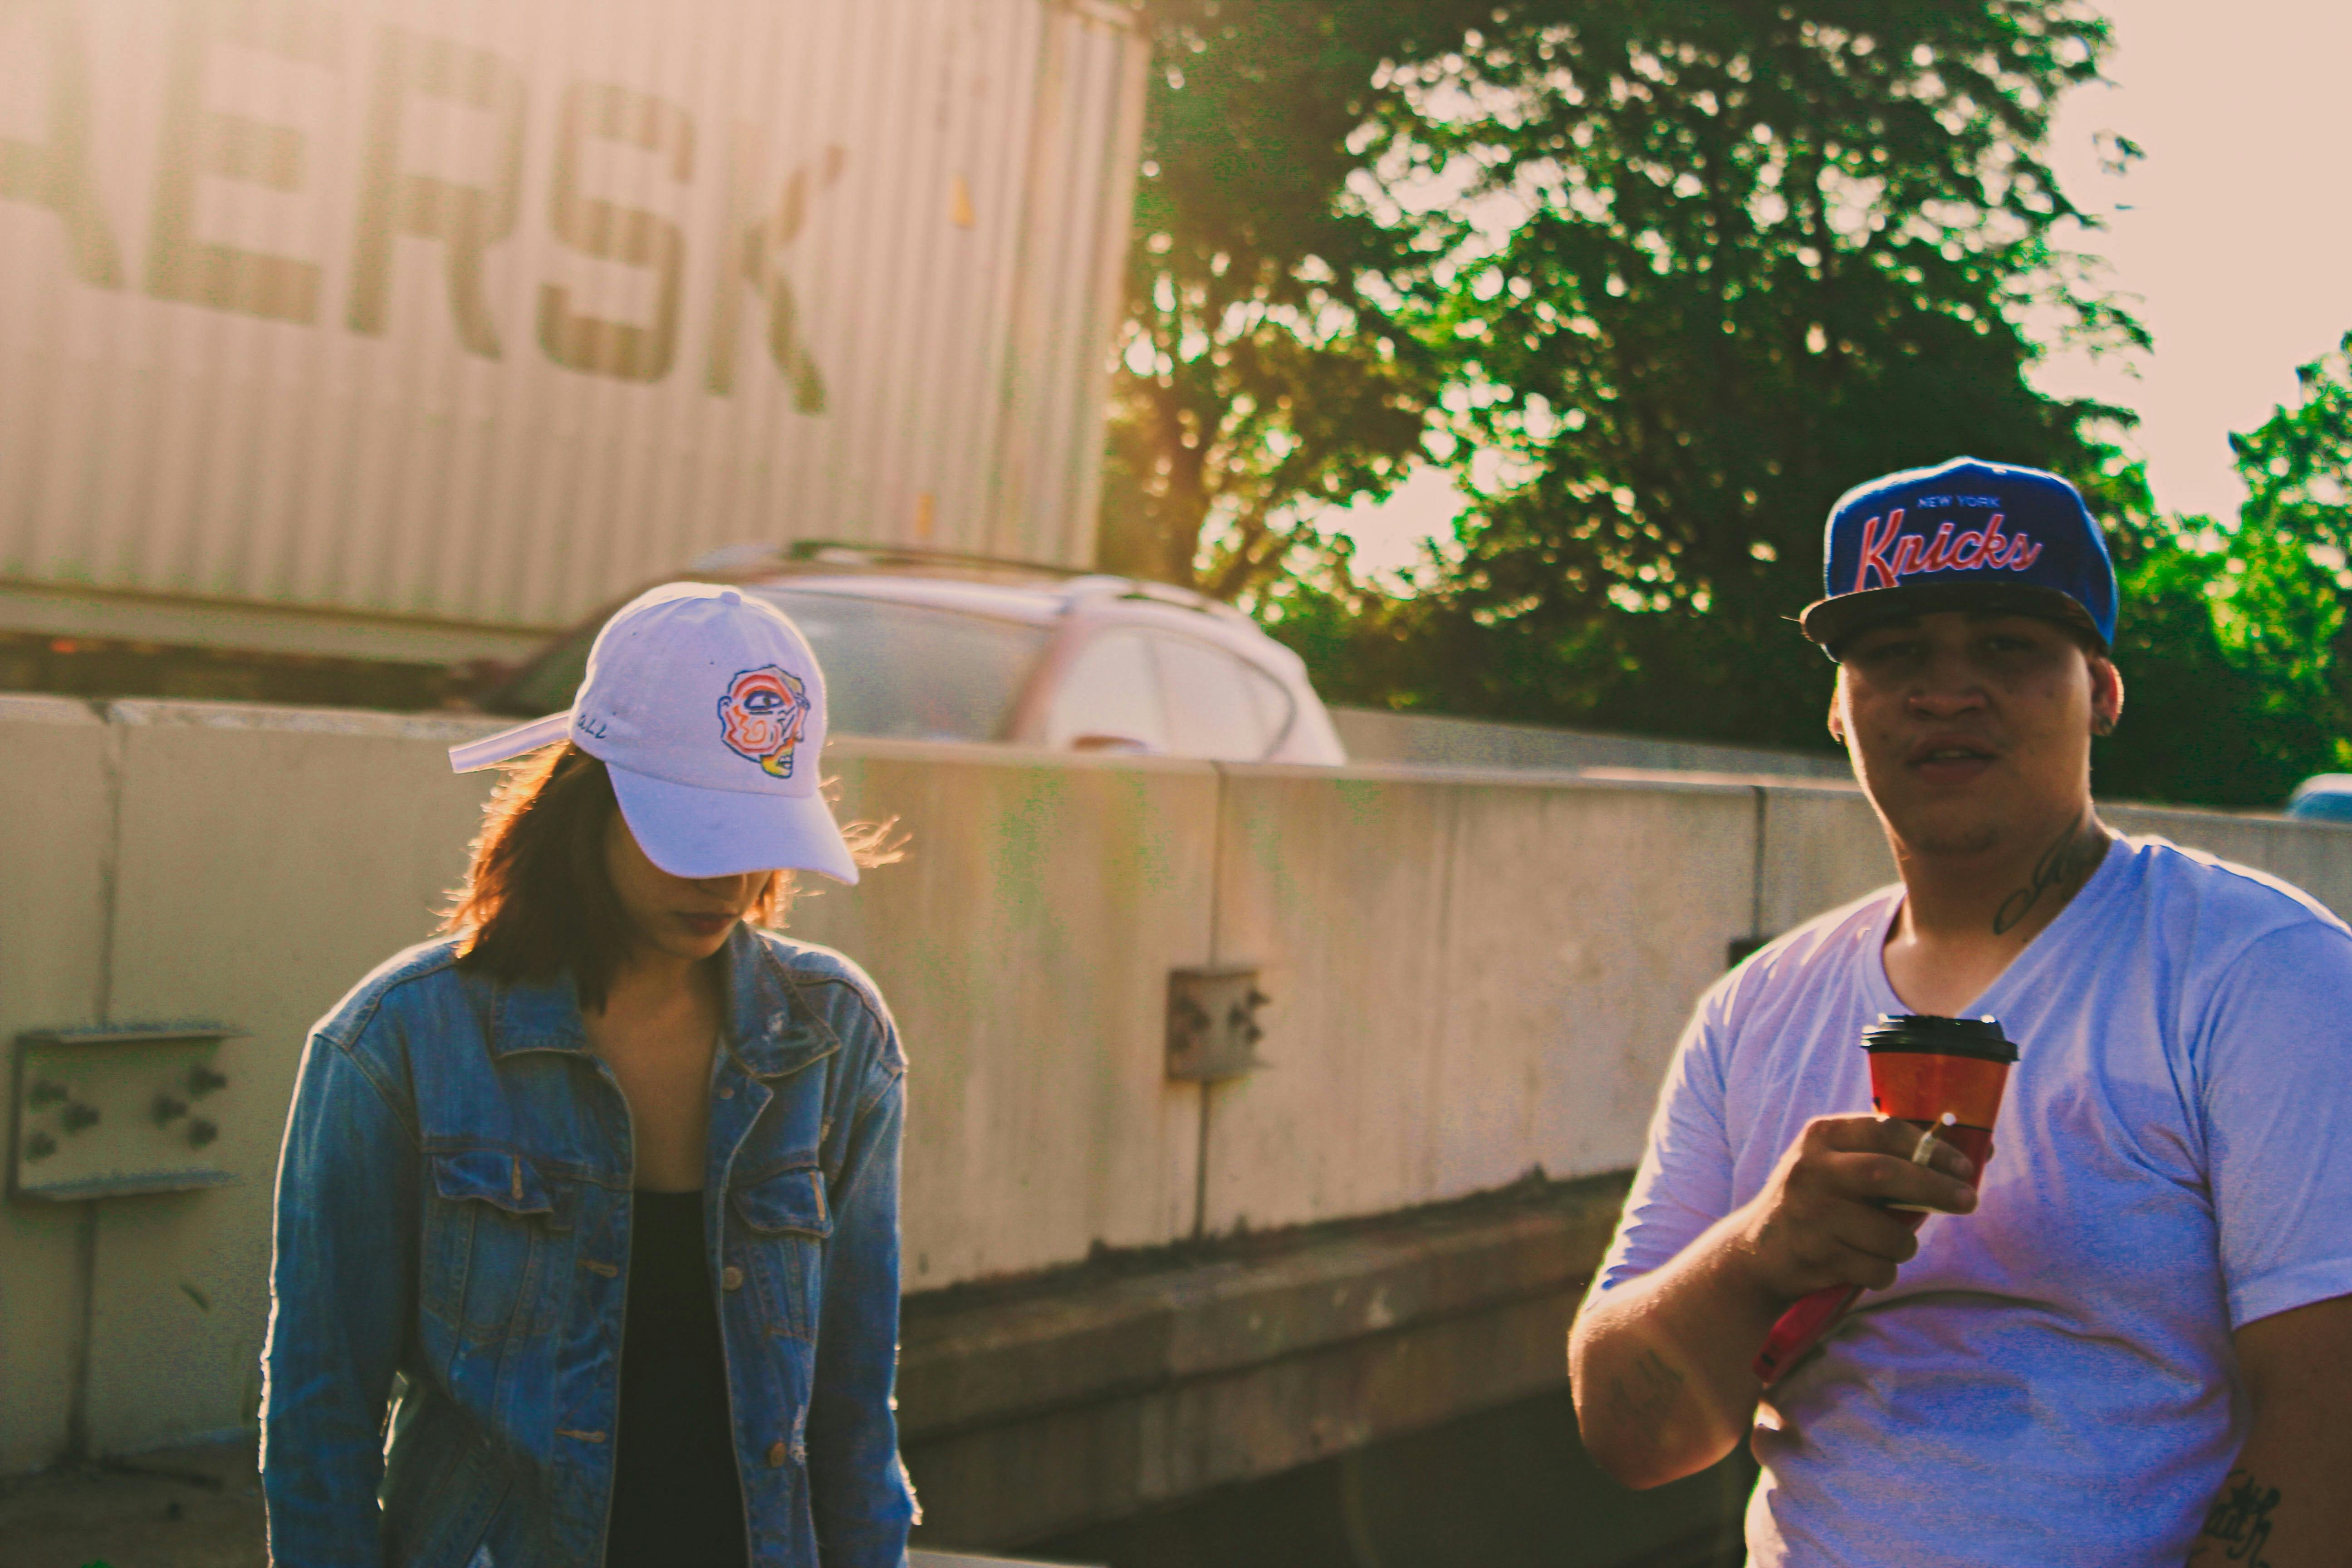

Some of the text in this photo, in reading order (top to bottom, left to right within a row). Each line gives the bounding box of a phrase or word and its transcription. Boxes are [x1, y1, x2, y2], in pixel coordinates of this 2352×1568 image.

[1917, 495, 2000, 508] NEW YORK
[1854, 508, 2043, 592] Knicks
